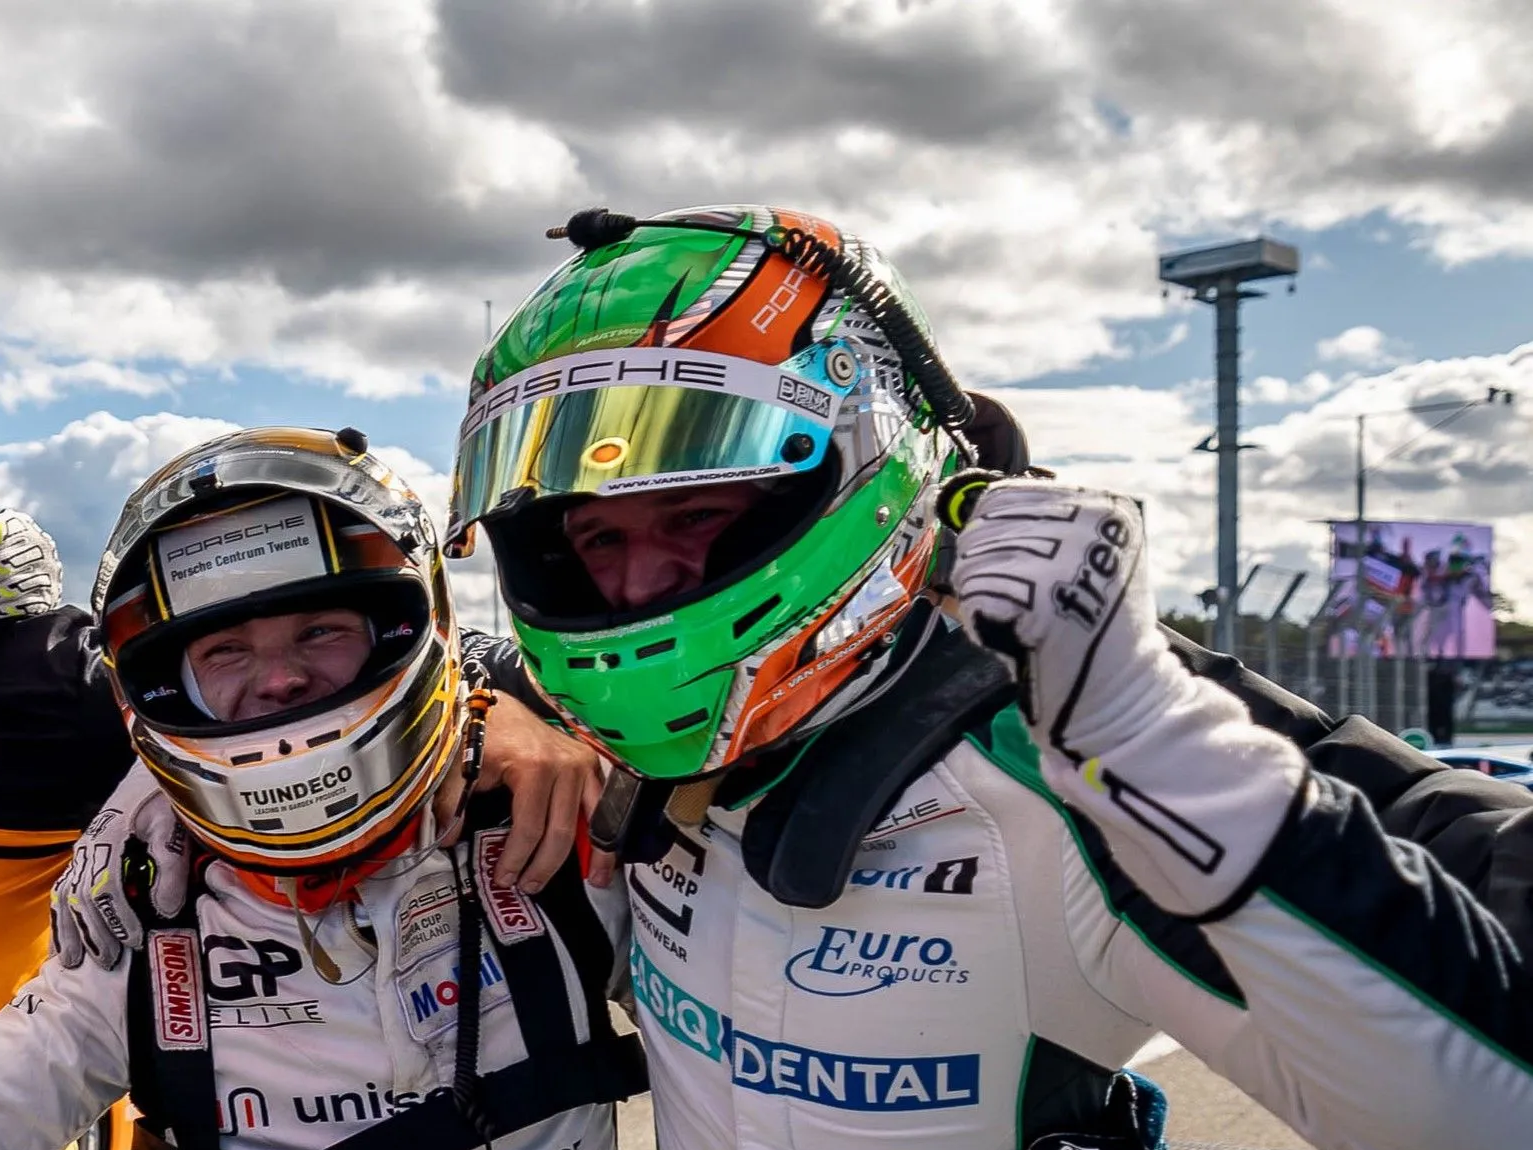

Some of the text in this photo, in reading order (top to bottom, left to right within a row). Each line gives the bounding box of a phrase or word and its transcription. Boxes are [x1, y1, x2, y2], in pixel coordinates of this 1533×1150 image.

[462, 358, 727, 440] ORSCHE
[166, 514, 306, 563] PORSCHE
[170, 535, 310, 582] Porsche Centrum Twente
[239, 765, 354, 807] TUINDECO
[421, 913, 442, 929] CUP
[203, 934, 303, 1002] GP
[808, 925, 955, 973] Euro
[848, 961, 970, 985] PRODUCTS
[163, 941, 195, 1037] SIMPSON
[734, 1040, 971, 1104] DENTAL
